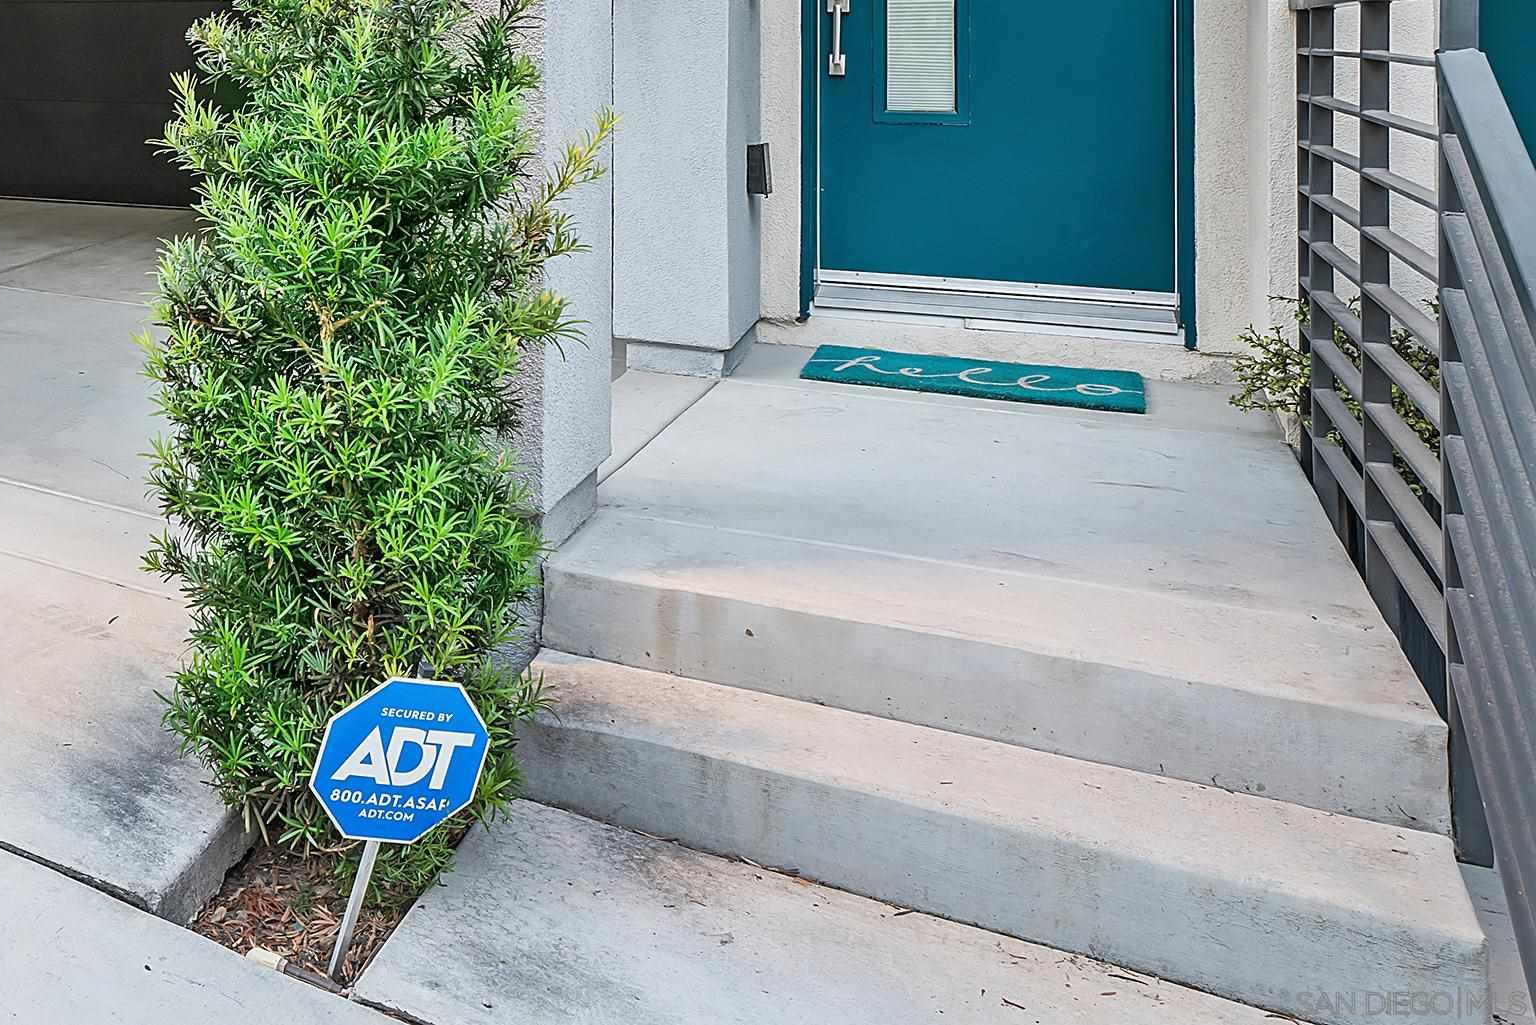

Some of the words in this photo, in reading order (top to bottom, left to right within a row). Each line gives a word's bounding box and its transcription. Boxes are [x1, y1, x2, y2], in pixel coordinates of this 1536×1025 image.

[380, 707, 436, 721] SECURED
[437, 712, 454, 723] BY
[330, 725, 476, 790] ADT
[358, 808, 415, 822] ADT.COM
